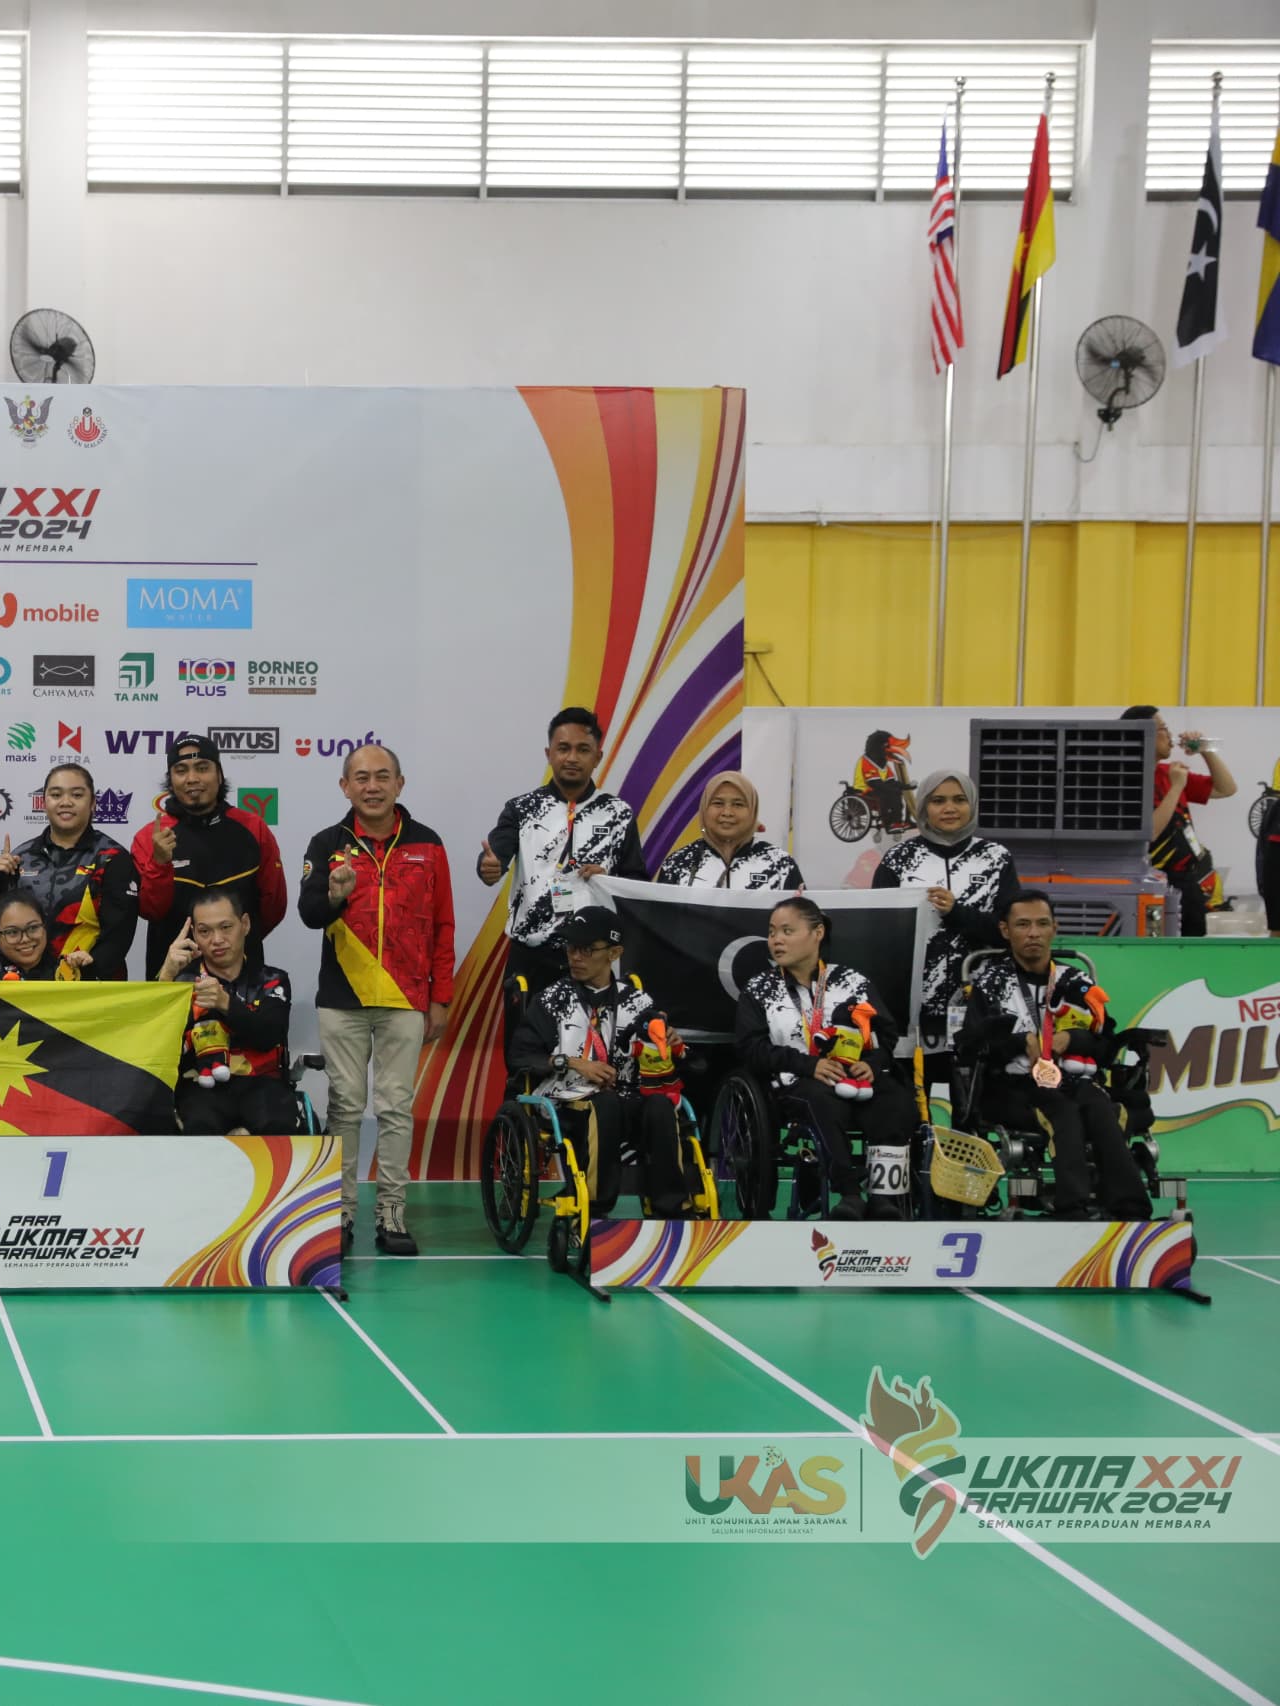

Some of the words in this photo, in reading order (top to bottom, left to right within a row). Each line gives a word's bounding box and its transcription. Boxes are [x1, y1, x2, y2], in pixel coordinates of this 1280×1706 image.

[7, 488, 101, 517] XXI
[16, 544, 74, 553] MEMBARA
[139, 586, 240, 611] MOMA
[23, 603, 100, 623] mobile
[181, 658, 230, 684] 100
[248, 661, 318, 675] BORNEO
[248, 676, 317, 686] SPRINGS
[114, 693, 130, 702] TA
[132, 693, 158, 702] ANN
[186, 686, 227, 697] PLUS
[5, 753, 37, 762] maxis
[50, 755, 91, 764] PETRA
[1147, 1024, 1280, 1094] MIL
[43, 1151, 68, 1197] 1
[869, 1162, 908, 1190] 206
[8, 1215, 62, 1227] PARA
[88, 1228, 145, 1246] XXI
[80, 1247, 140, 1259] 2024
[935, 1232, 983, 1278] 3
[883, 1256, 911, 1265] XXI
